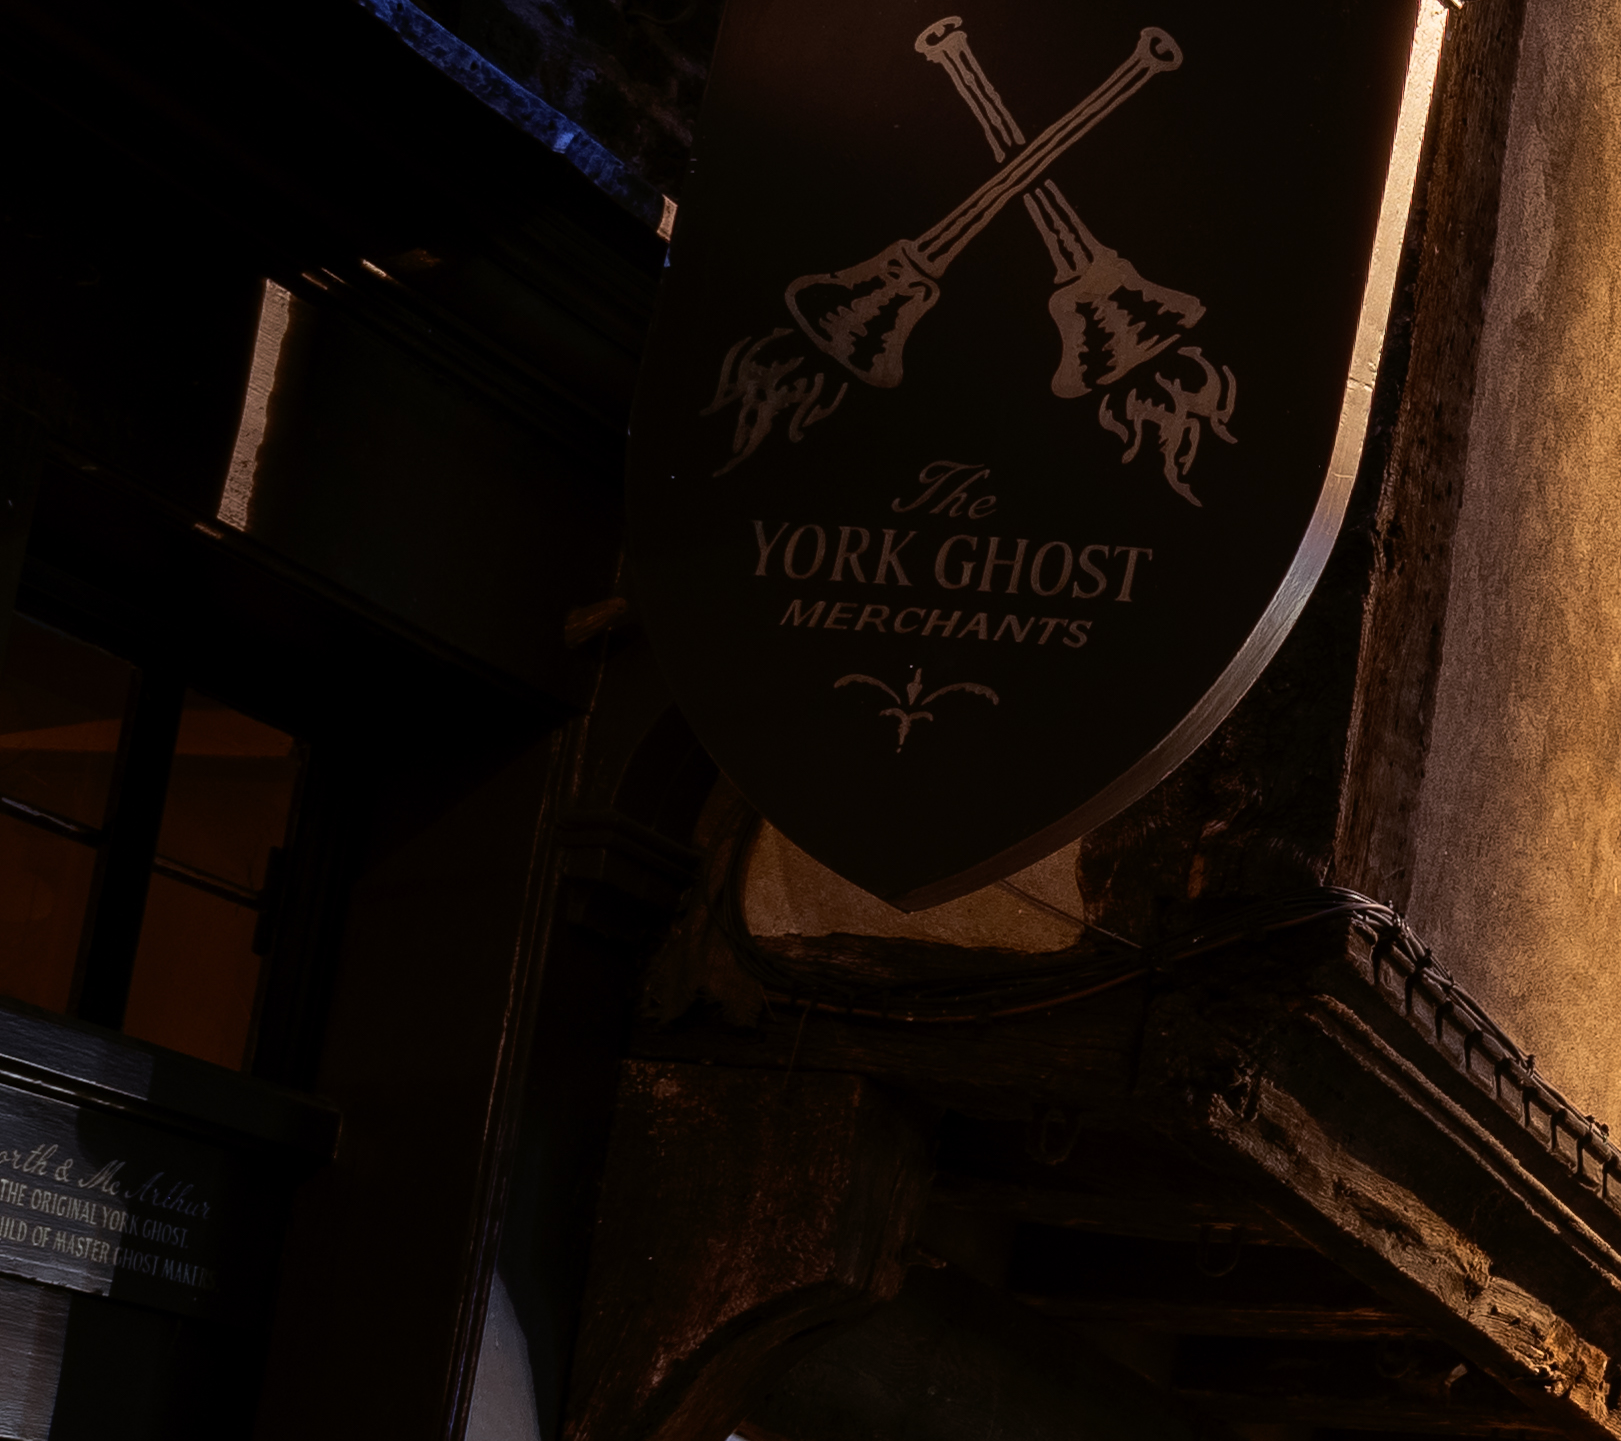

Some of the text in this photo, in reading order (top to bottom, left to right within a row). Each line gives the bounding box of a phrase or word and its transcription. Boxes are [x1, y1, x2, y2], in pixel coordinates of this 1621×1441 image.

[890, 460, 998, 519] The
[751, 519, 1154, 603] YORK GHOST
[779, 598, 1093, 649] MERCHANTS
[54, 1158, 74, 1183] &
[0, 1178, 28, 1207] THE
[30, 1188, 98, 1226] ORIGINAL
[101, 1205, 139, 1237] YORK
[32, 1225, 52, 1248] OF
[52, 1229, 111, 1264] MASTER
[113, 1246, 160, 1276] GHOST
